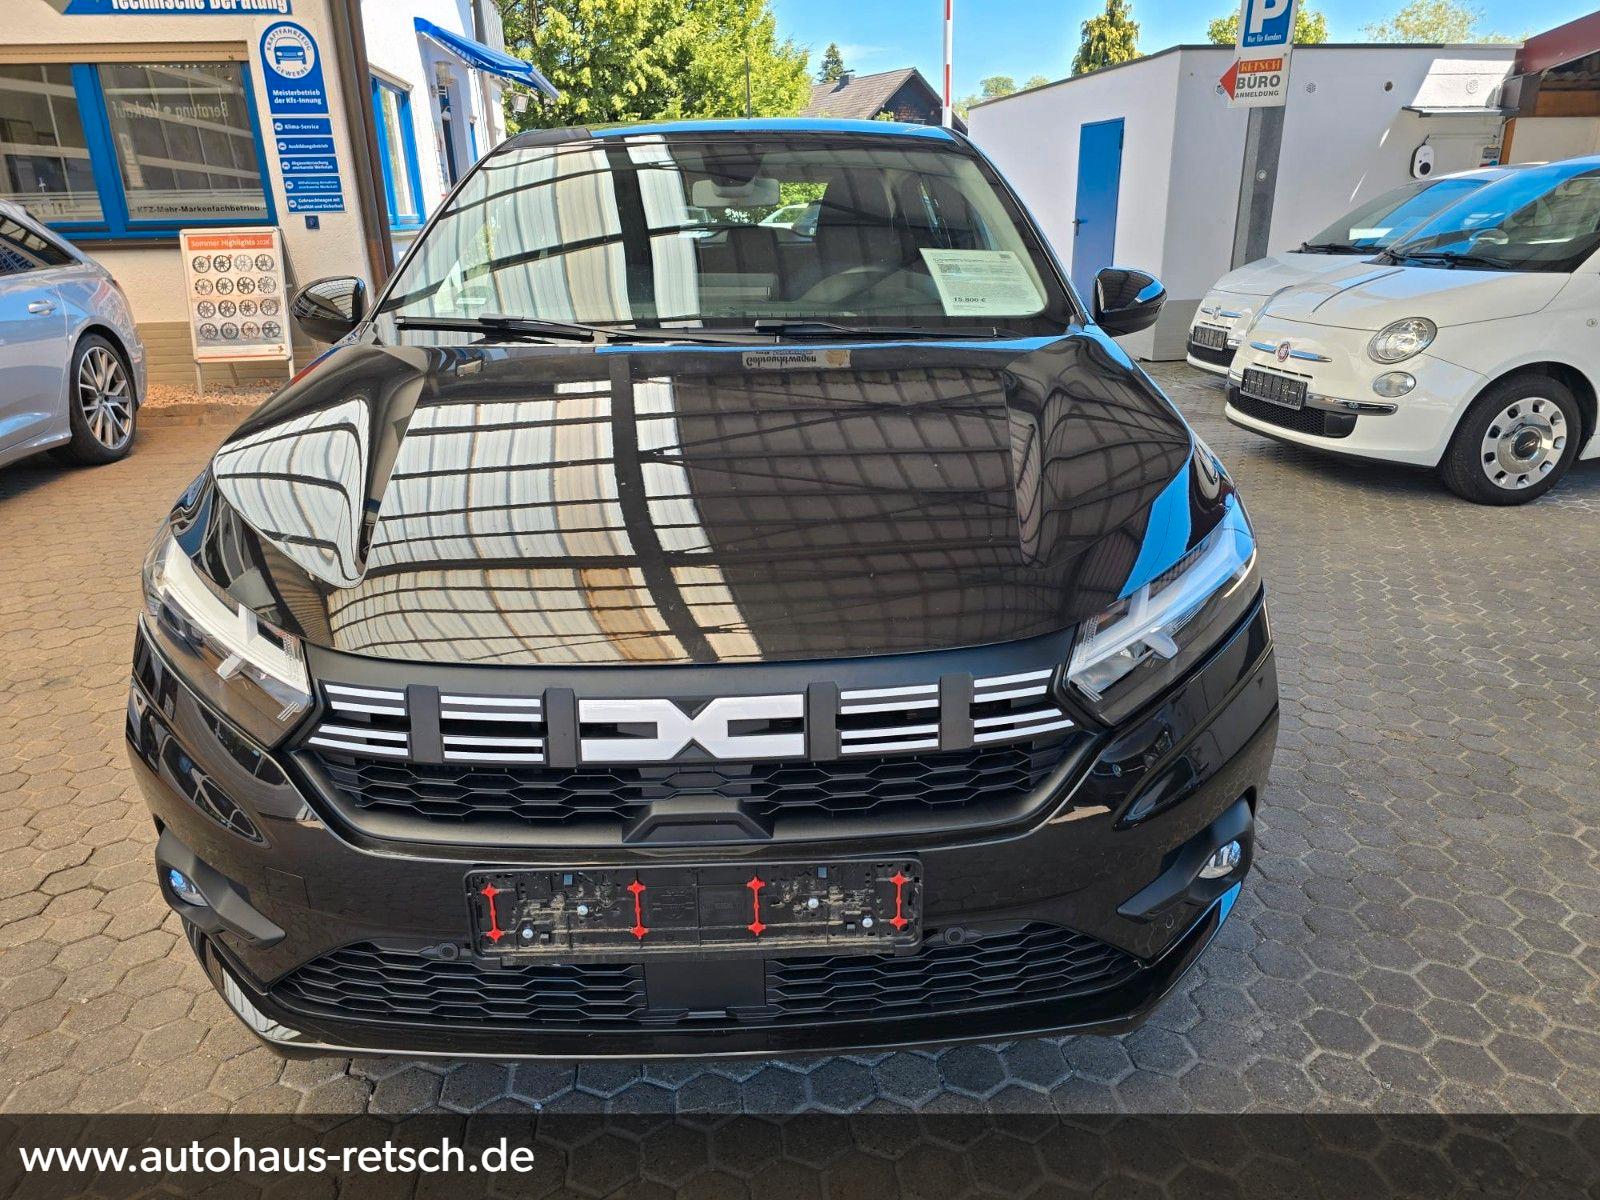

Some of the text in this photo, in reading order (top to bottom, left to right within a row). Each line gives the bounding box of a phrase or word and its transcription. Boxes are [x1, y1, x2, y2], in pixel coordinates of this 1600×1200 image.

[1247, 33, 1282, 43] Nur für Kunden
[1240, 60, 1281, 72] RETSCH
[276, 66, 308, 77] GEWERBE
[1237, 74, 1281, 90] BÜRO
[272, 88, 321, 96] Meisterbetrieb
[1235, 90, 1279, 98] ANMELDUNG
[221, 238, 256, 248] Highlights
